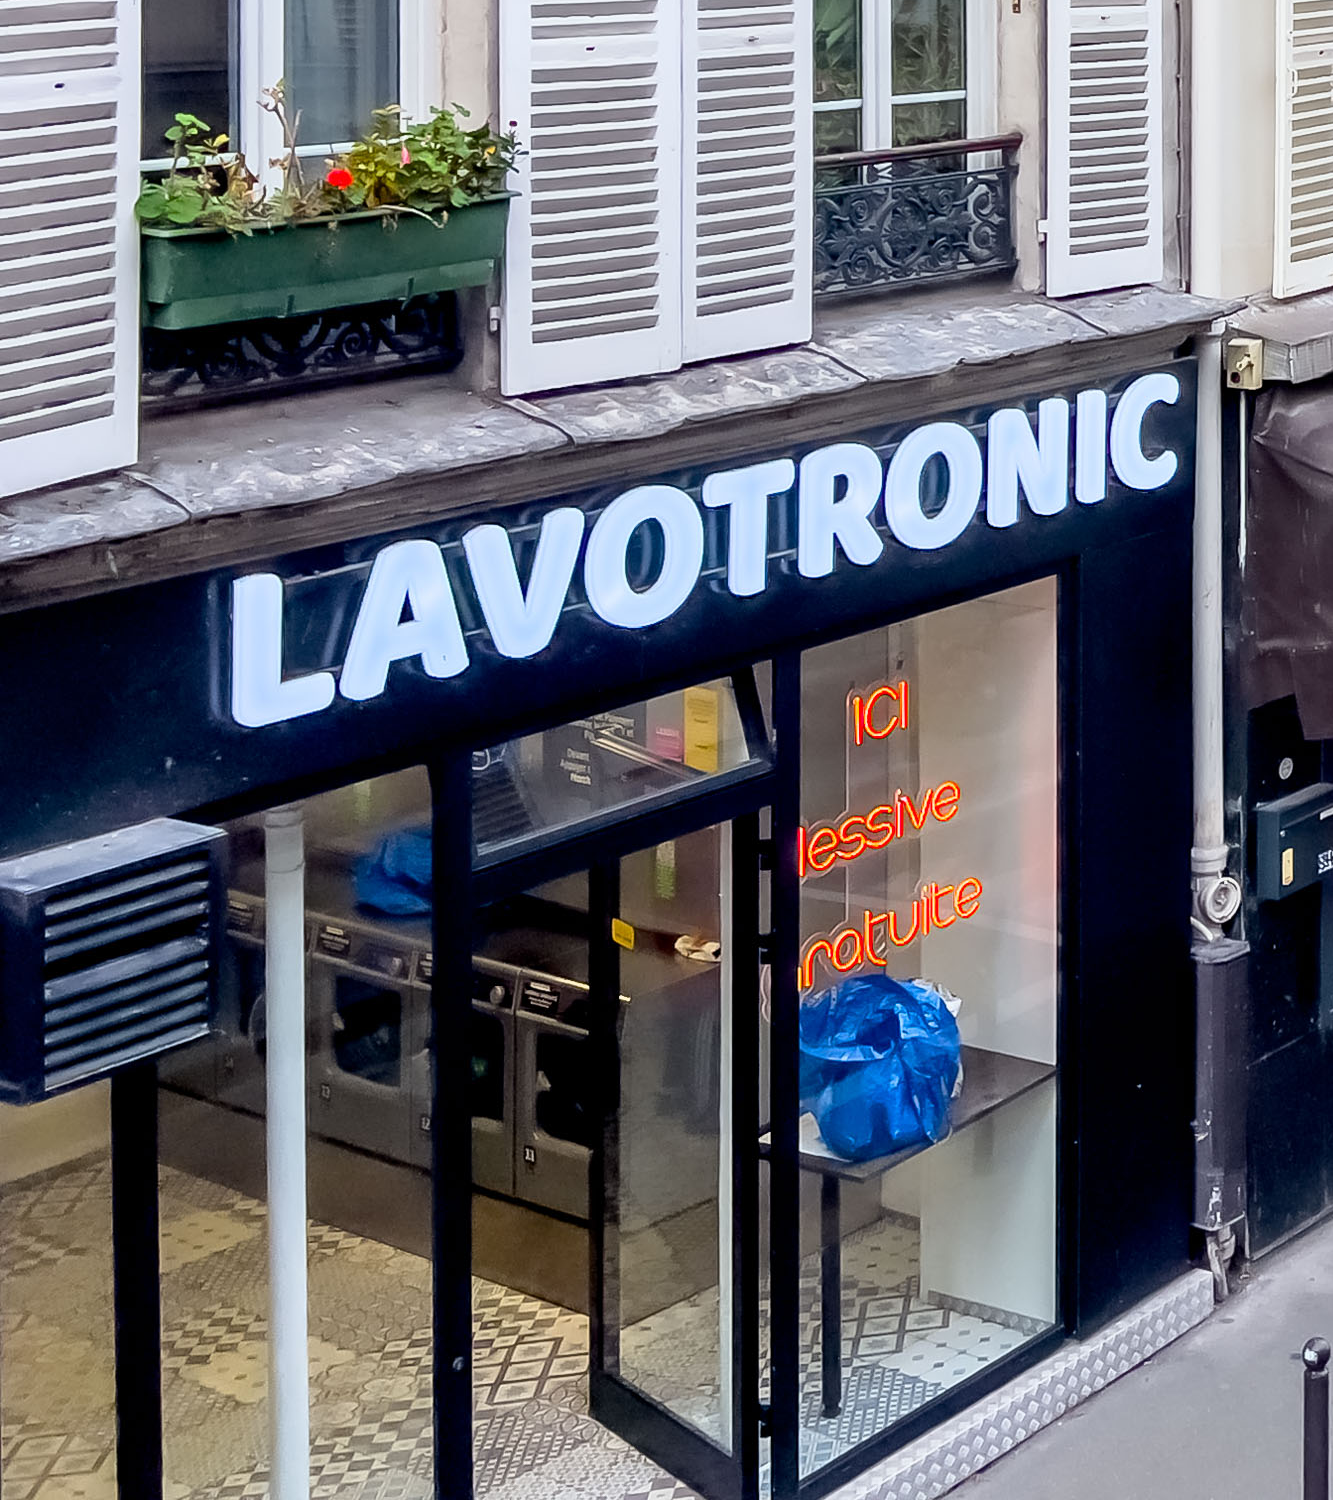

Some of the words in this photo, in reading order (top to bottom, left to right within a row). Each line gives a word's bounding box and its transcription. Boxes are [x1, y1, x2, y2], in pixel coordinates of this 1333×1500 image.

[231, 371, 1181, 729] LAVOTRONIC
[852, 679, 908, 746] ICI
[796, 780, 961, 878] lessive
[797, 876, 984, 992] ratuite
